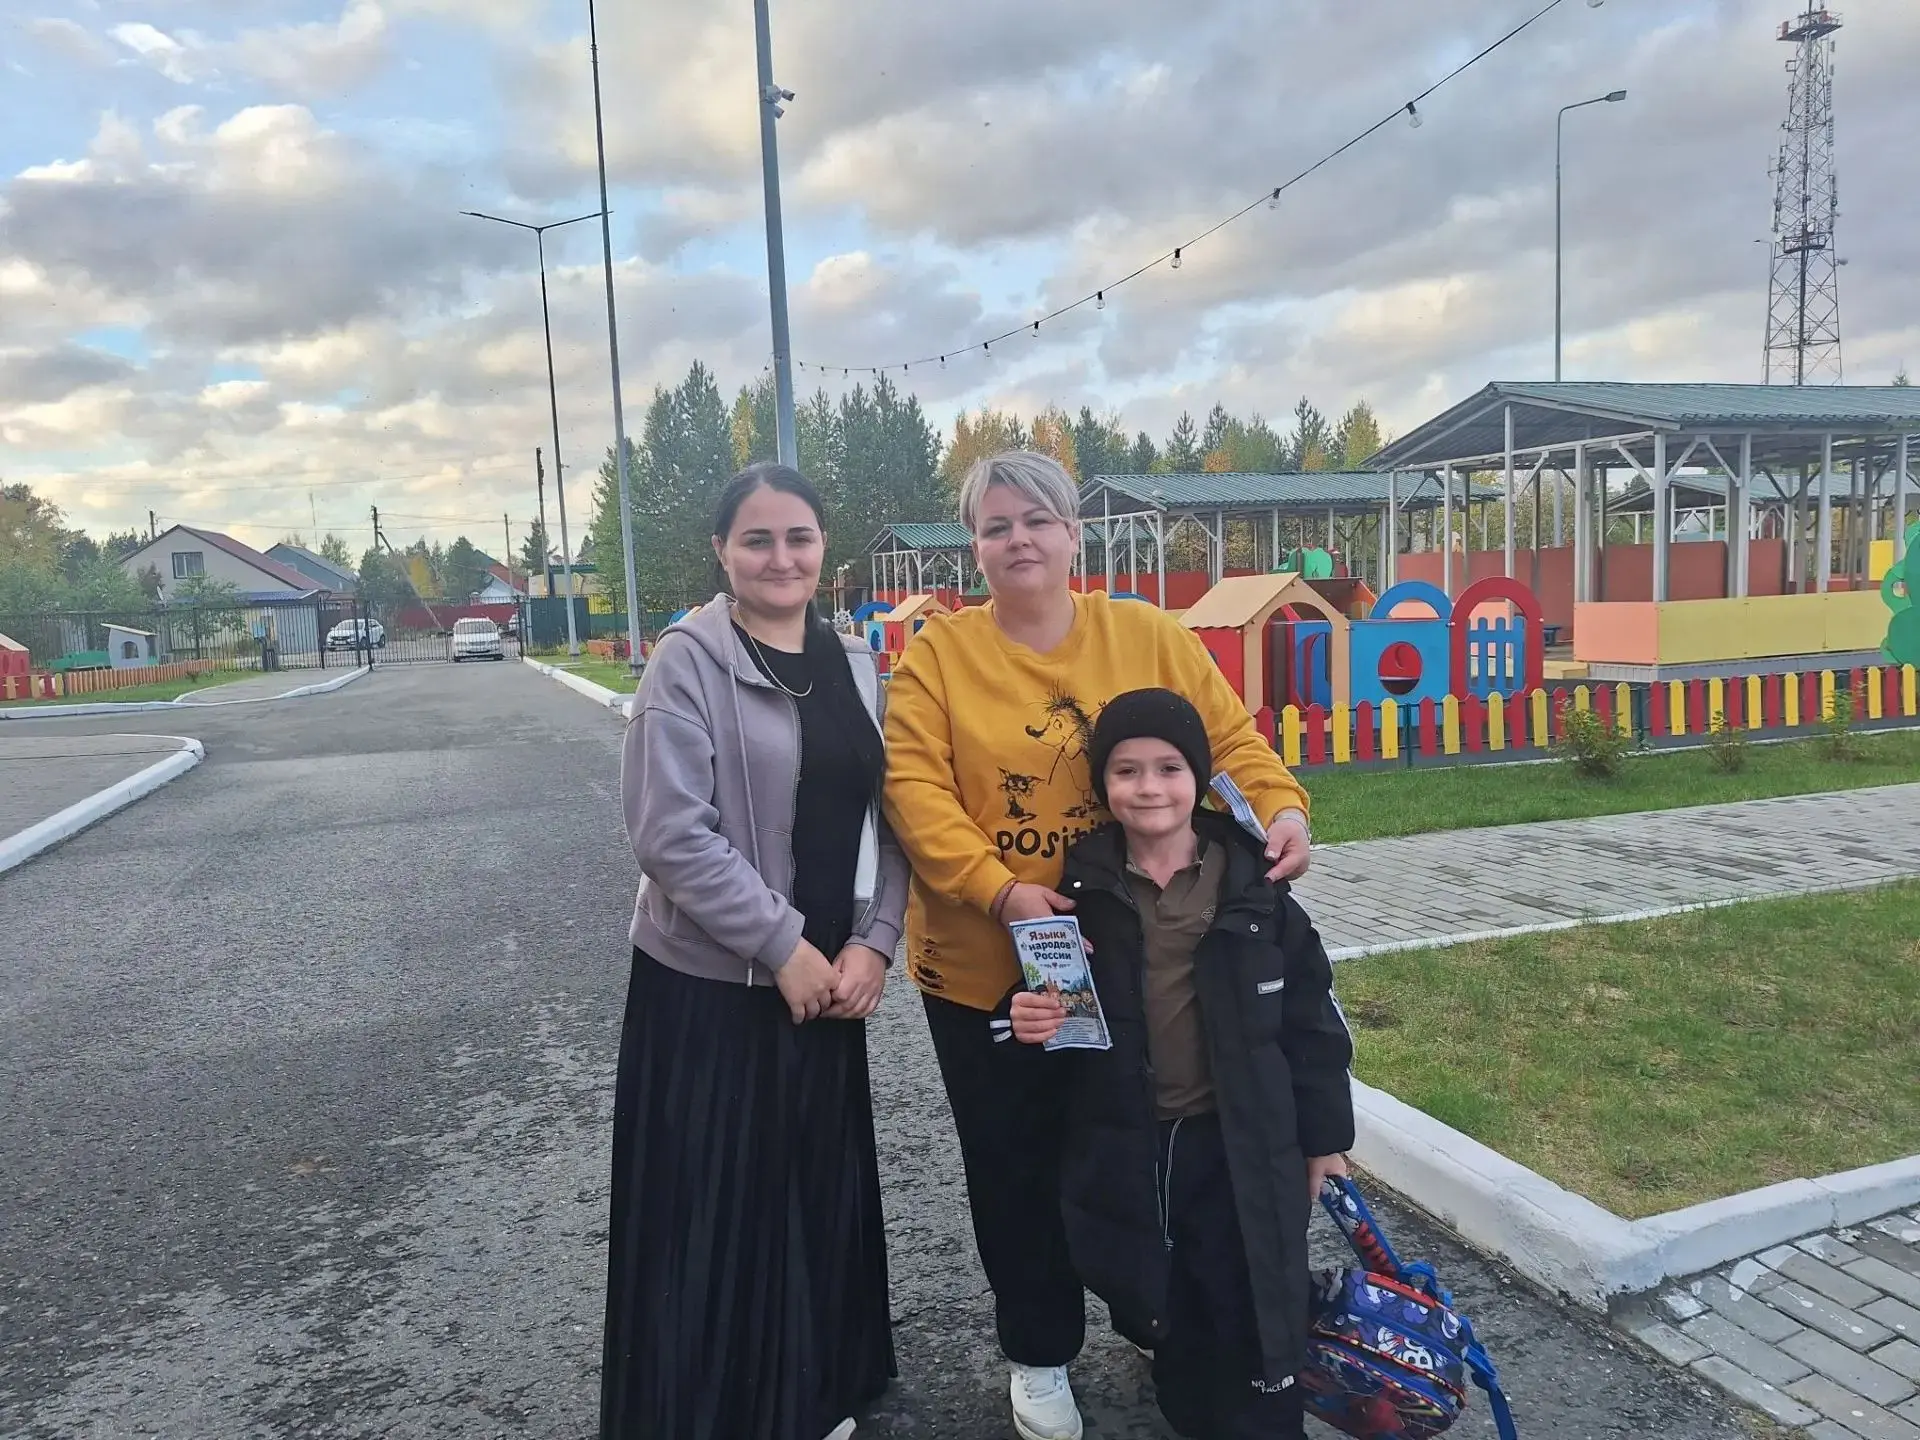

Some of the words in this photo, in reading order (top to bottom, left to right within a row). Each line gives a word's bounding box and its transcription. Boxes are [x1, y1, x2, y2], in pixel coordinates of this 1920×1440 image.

[1029, 931, 1067, 941] Языки
[1028, 941, 1071, 952] народов
[1034, 951, 1072, 961] России
